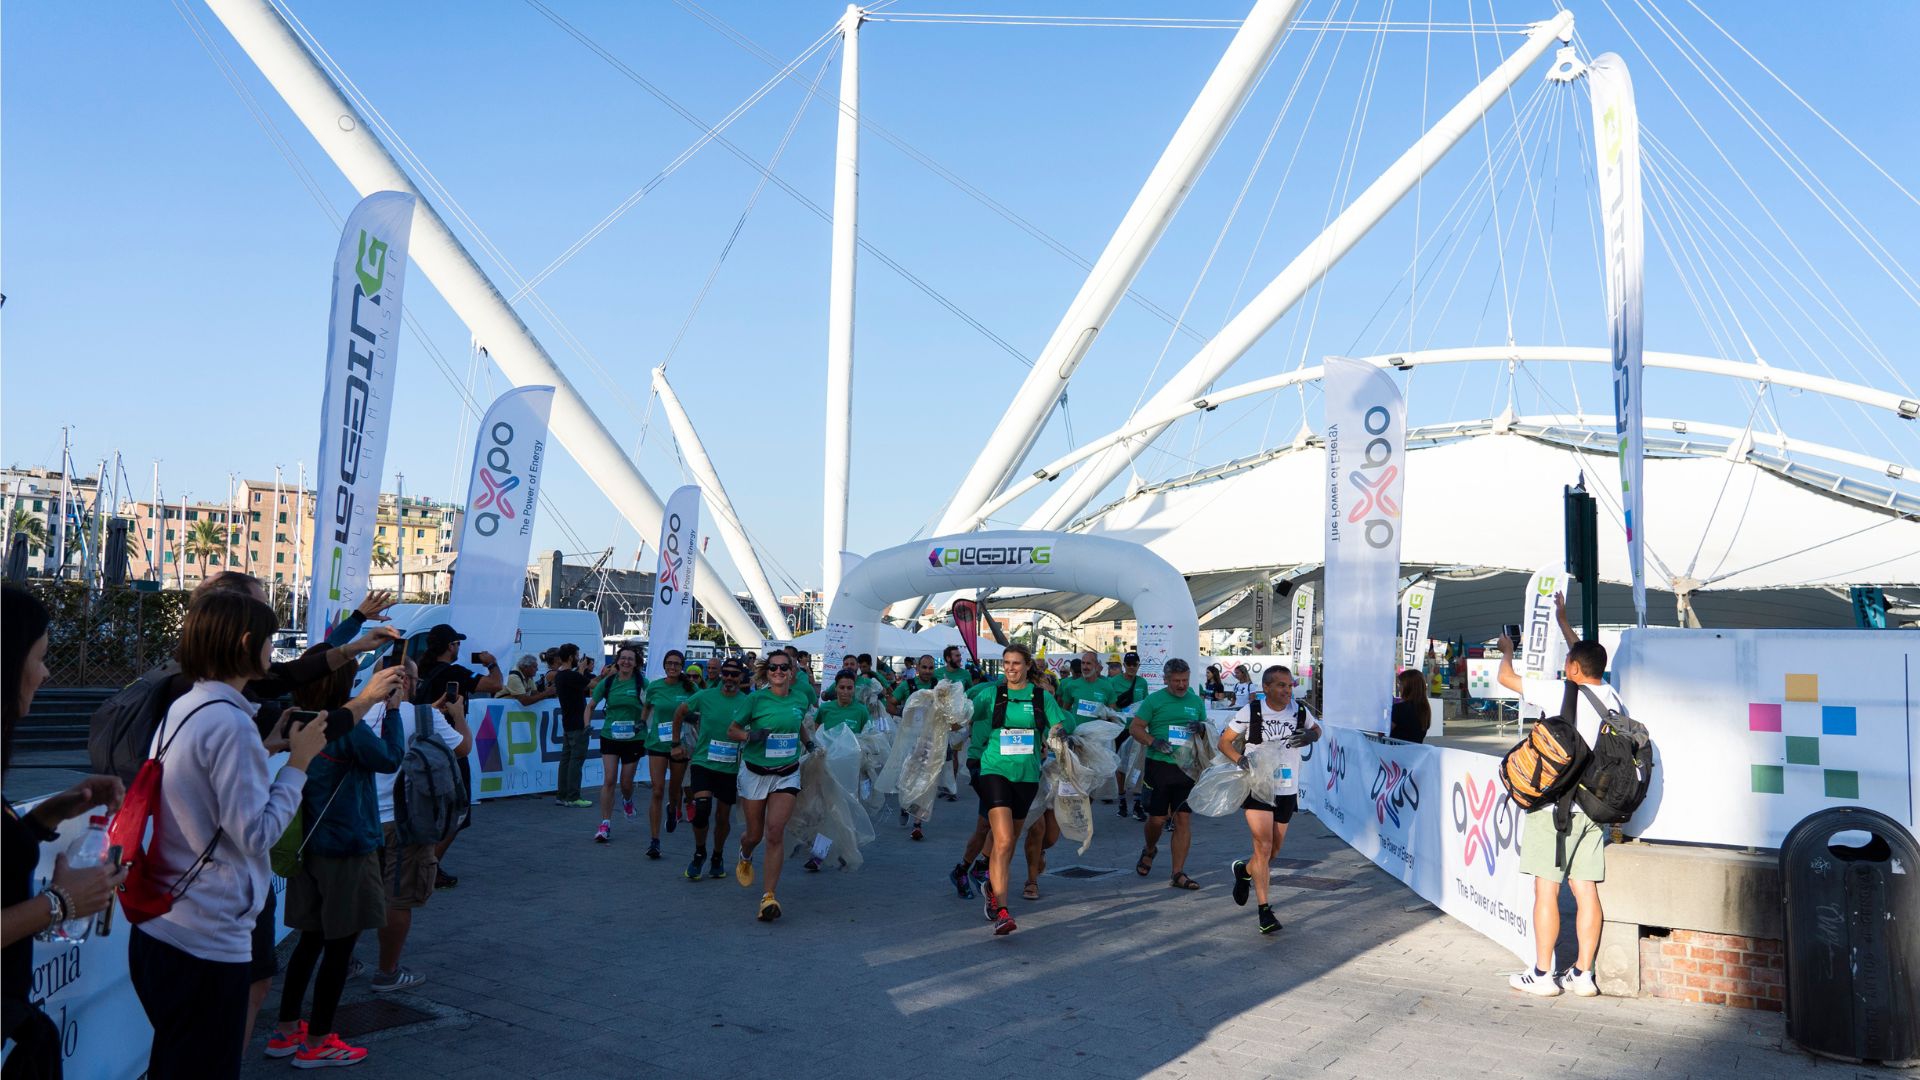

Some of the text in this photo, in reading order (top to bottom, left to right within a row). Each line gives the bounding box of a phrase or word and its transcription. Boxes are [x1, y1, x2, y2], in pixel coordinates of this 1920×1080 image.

[329, 228, 388, 601] PLOGGING
[475, 421, 519, 537] axpo
[519, 440, 543, 537] The Power of Energy
[343, 502, 366, 602] WORLD
[660, 513, 681, 605] axpo
[682, 529, 697, 606] The Power of Energy
[944, 546, 1051, 565] PLOGGING
[505, 768, 556, 792] WORL
[1012, 735, 1022, 744] 32
[1456, 877, 1527, 937] The Power of Energy
